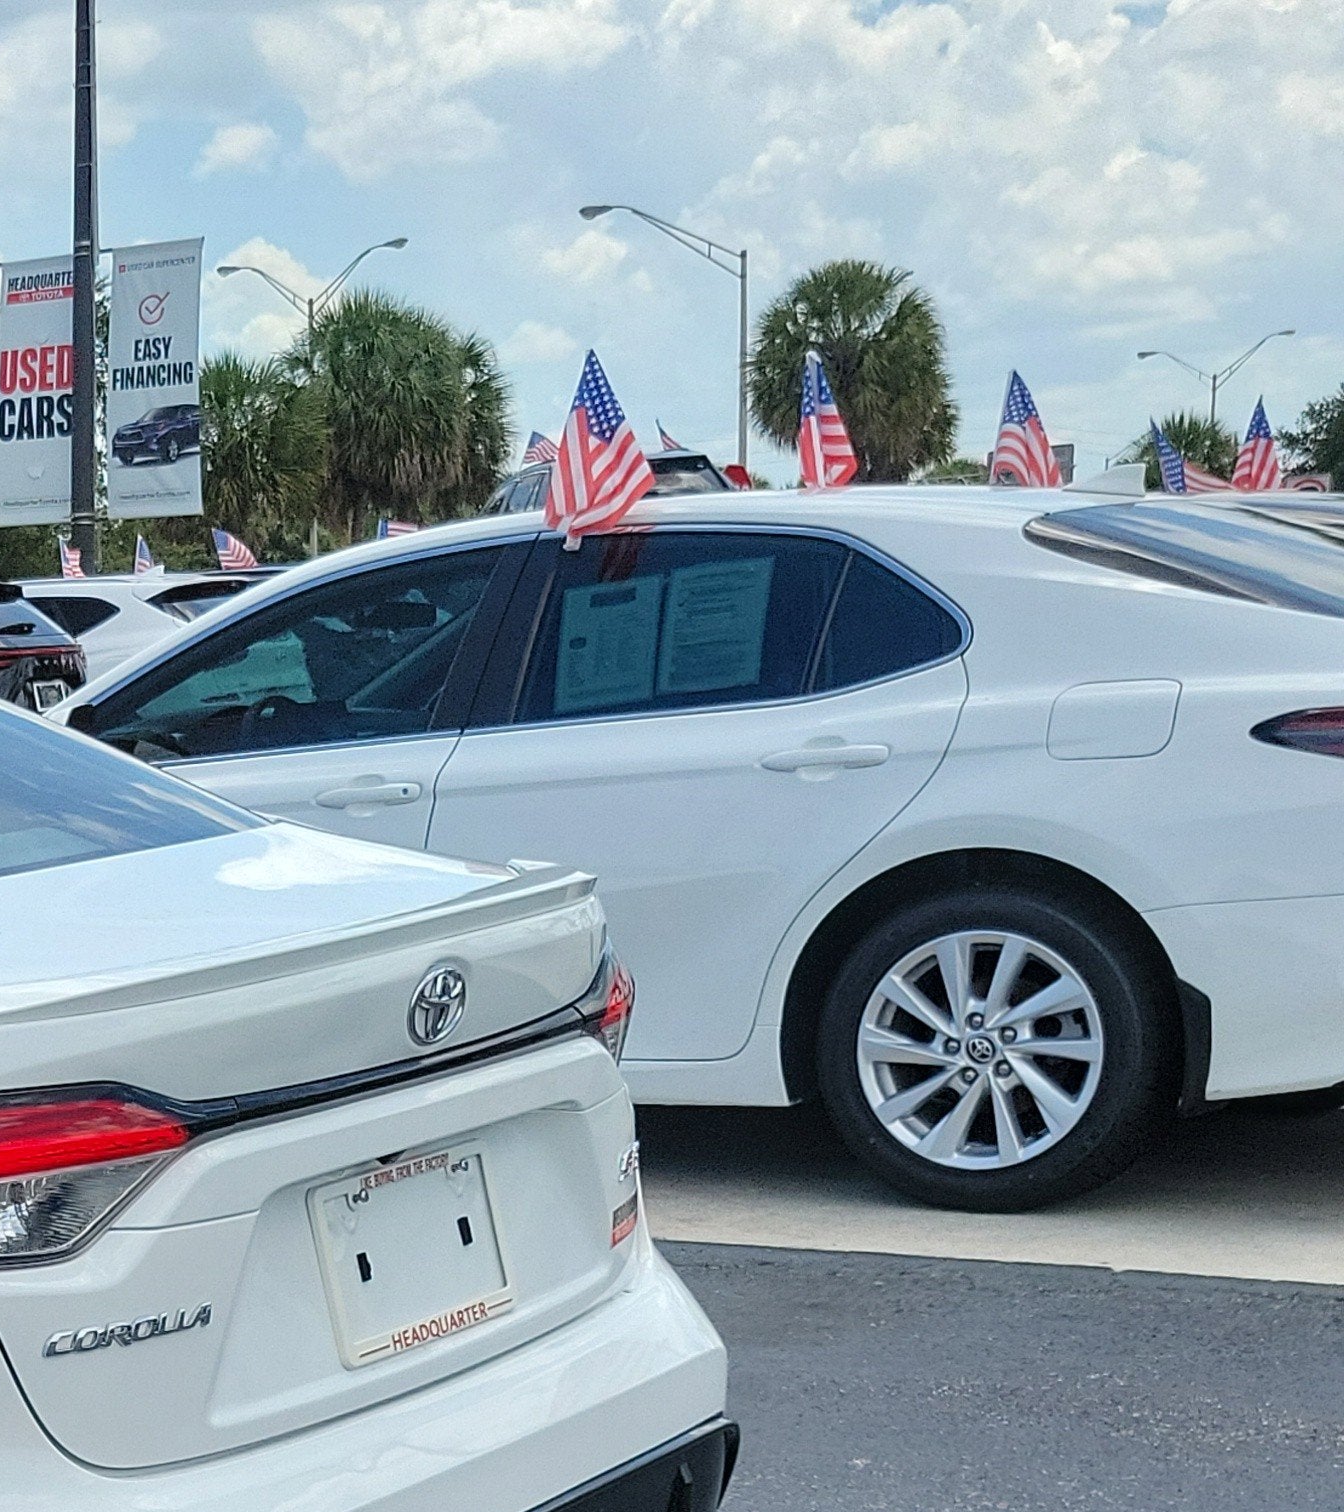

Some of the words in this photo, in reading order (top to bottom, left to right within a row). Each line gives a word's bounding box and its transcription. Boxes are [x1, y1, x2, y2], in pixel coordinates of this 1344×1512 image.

[8, 271, 72, 292] HEADQUARTE
[31, 289, 64, 302] TOYOTA
[134, 336, 172, 362] EASY
[0, 345, 73, 395] USED
[113, 362, 193, 391] FINANCING
[42, 1301, 211, 1358] COROLLA
[391, 1301, 489, 1351] HEADQUARTER
